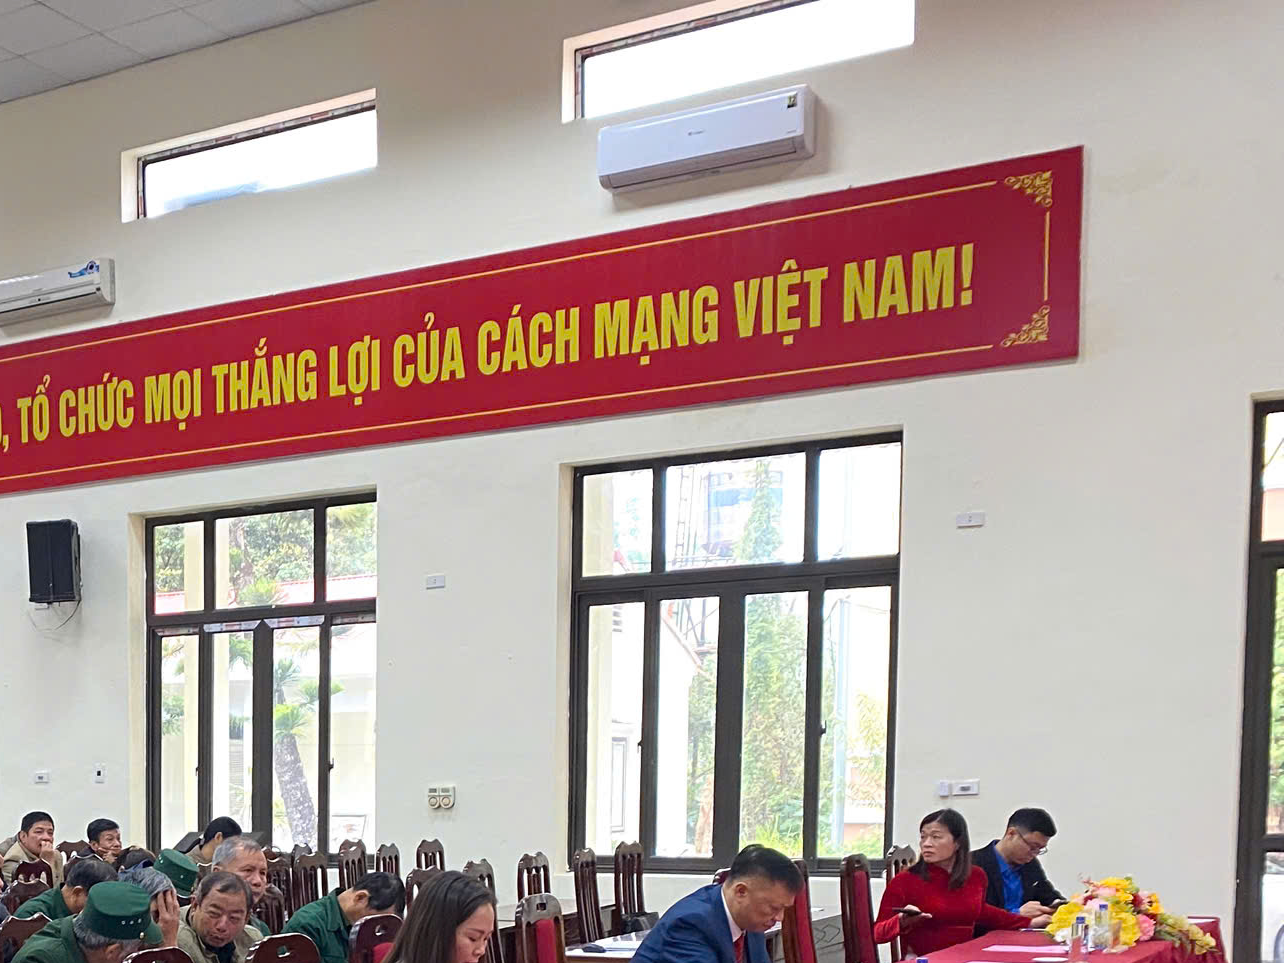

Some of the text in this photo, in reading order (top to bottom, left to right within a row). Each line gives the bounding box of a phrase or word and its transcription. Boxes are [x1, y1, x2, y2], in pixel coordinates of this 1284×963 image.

[17, 374, 51, 444] TỔ
[59, 372, 134, 438] CHỨC
[145, 367, 202, 431] MỌI
[212, 337, 317, 414] THẮNG
[329, 335, 381, 406] LỢI
[393, 311, 466, 388] CỦA
[478, 303, 580, 376] CÁCH
[594, 285, 719, 366] MẠNG
[734, 259, 829, 345] VIỆT
[843, 243, 975, 323] NAM!
